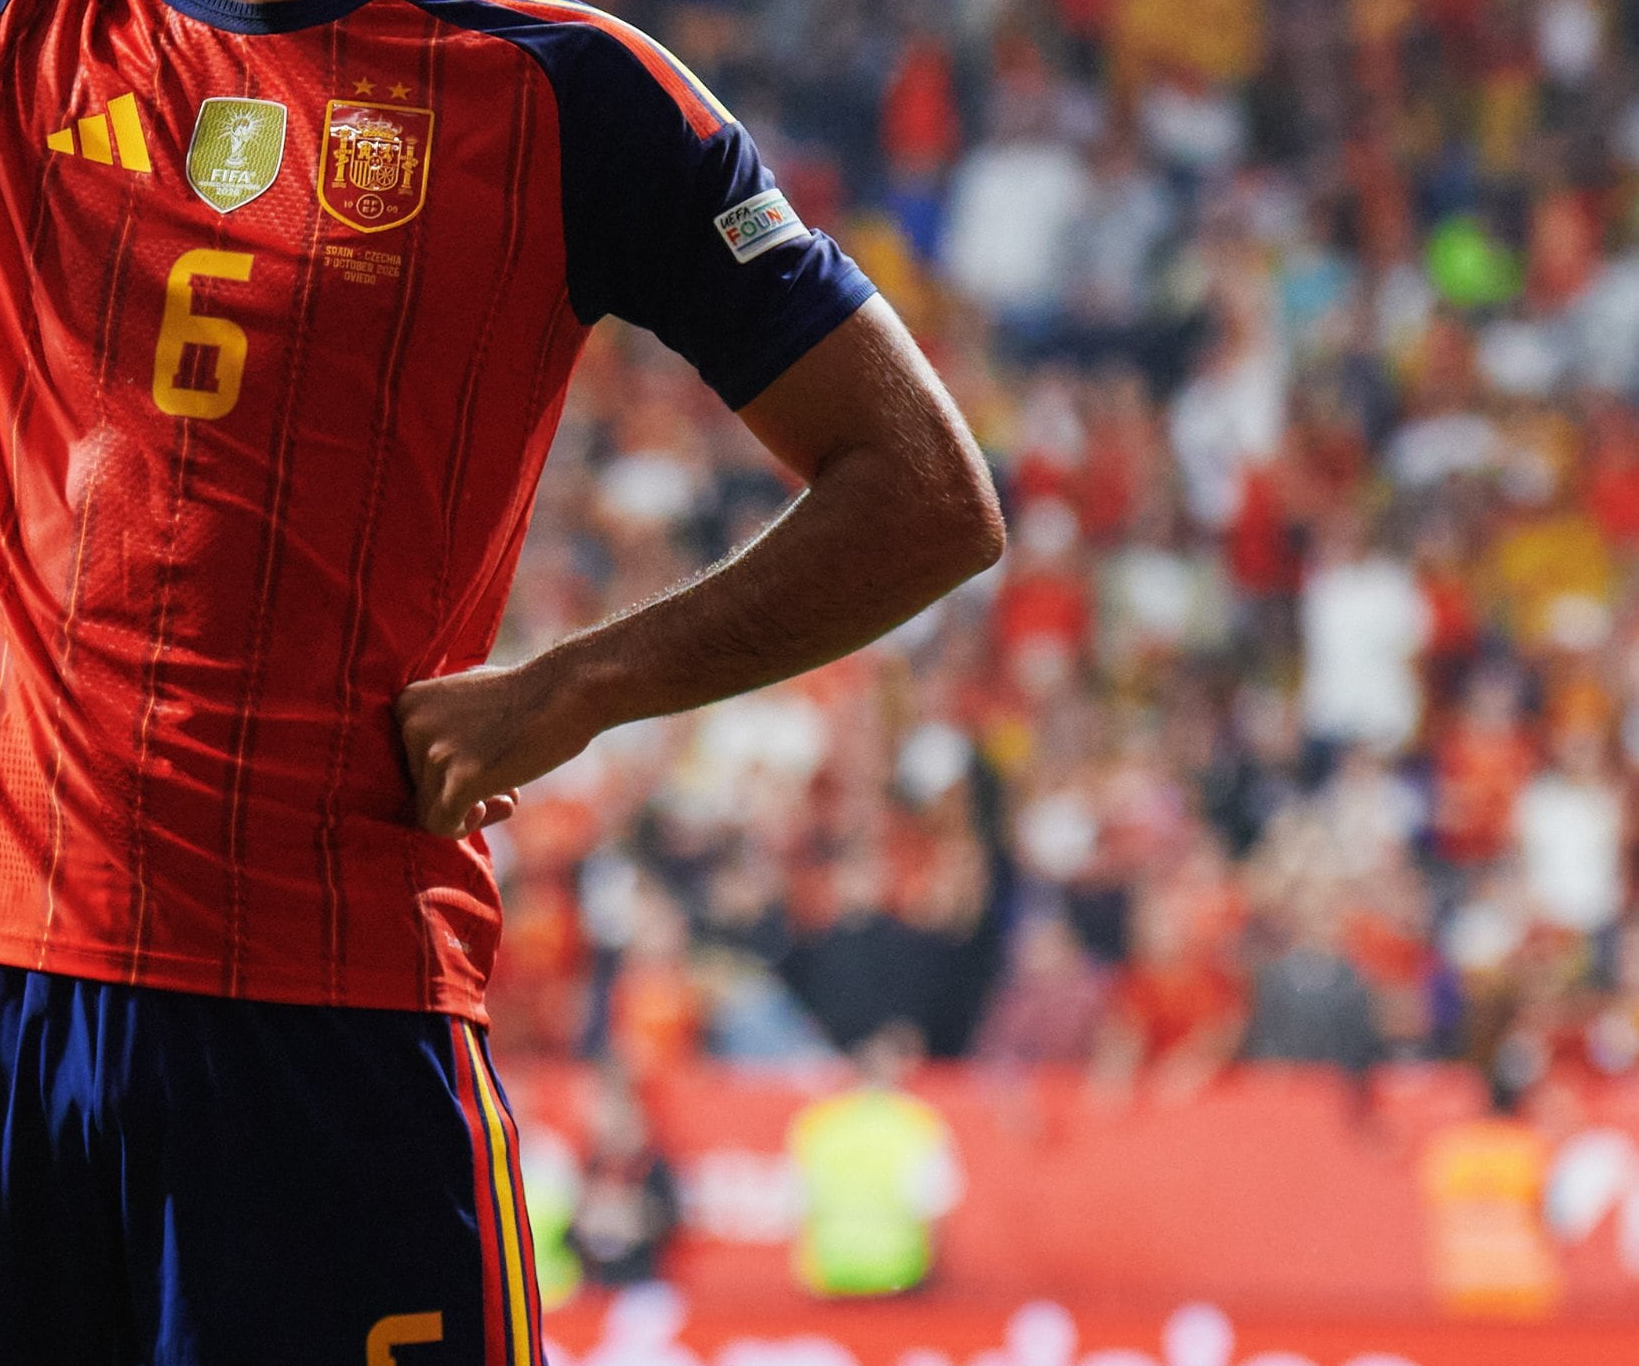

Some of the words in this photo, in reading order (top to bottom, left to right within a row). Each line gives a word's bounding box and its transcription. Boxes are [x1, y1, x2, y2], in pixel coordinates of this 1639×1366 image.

[210, 168, 250, 184] FIFA
[720, 206, 751, 230] UEFA
[333, 258, 375, 273] OCTOBER
[364, 250, 402, 266] CZECHIA
[344, 270, 377, 285] OVIEDO
[152, 247, 255, 420] 6
